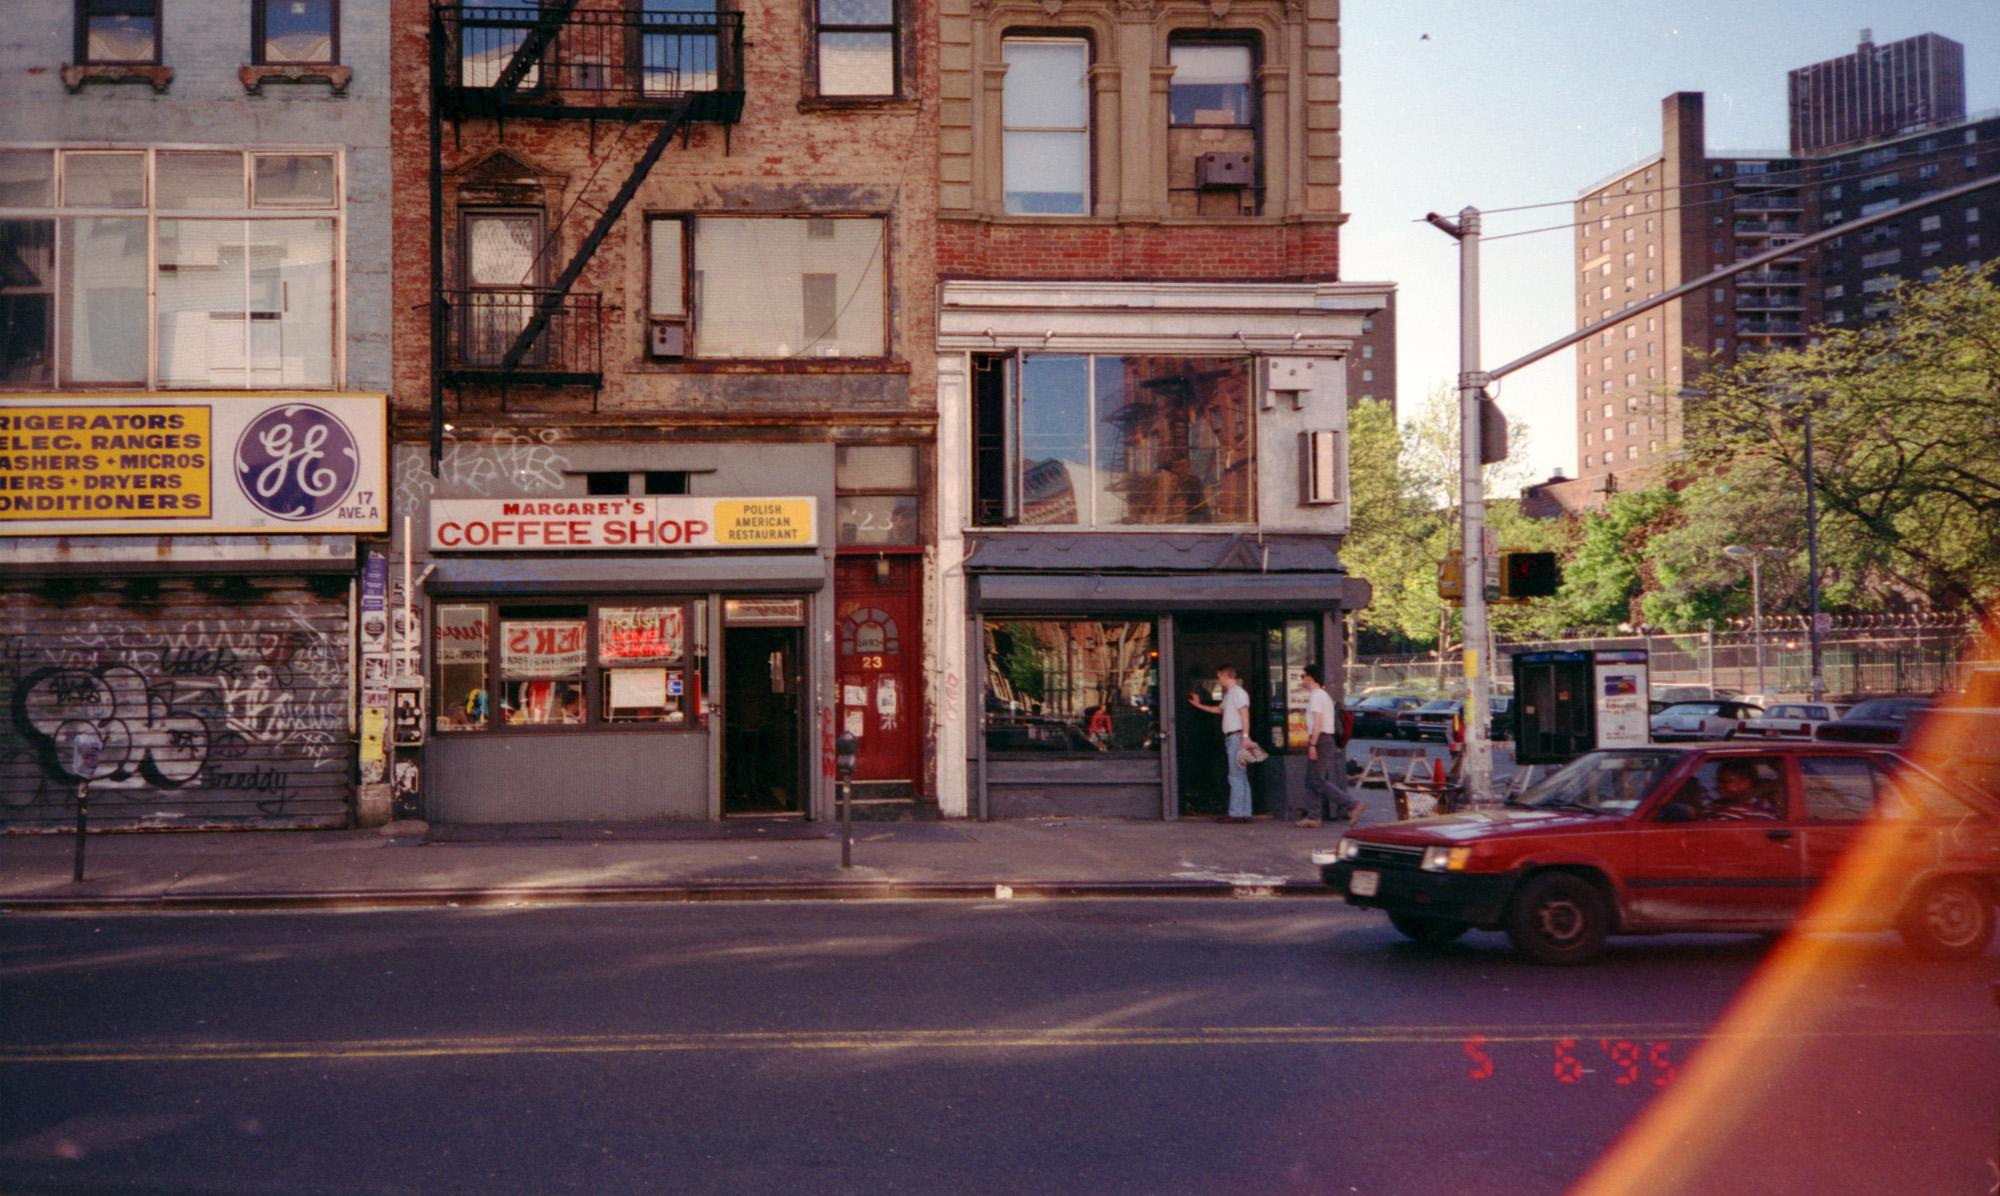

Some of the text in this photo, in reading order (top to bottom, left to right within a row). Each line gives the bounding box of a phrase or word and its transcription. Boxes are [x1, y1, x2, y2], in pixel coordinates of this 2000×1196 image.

[91, 434, 201, 450] RANGES
[120, 453, 205, 469] MICROS
[84, 474, 182, 489] DRYERS
[358, 491, 374, 505] 17
[338, 506, 379, 519] AVE. A
[503, 498, 645, 516] MARGARET'S
[743, 504, 782, 515] POLISH
[735, 517, 791, 528] AMERICAN
[858, 511, 894, 530] 23
[437, 519, 709, 547] COFFEE SHOP
[728, 528, 798, 540] RESTAURANT
[862, 656, 883, 669] 23
